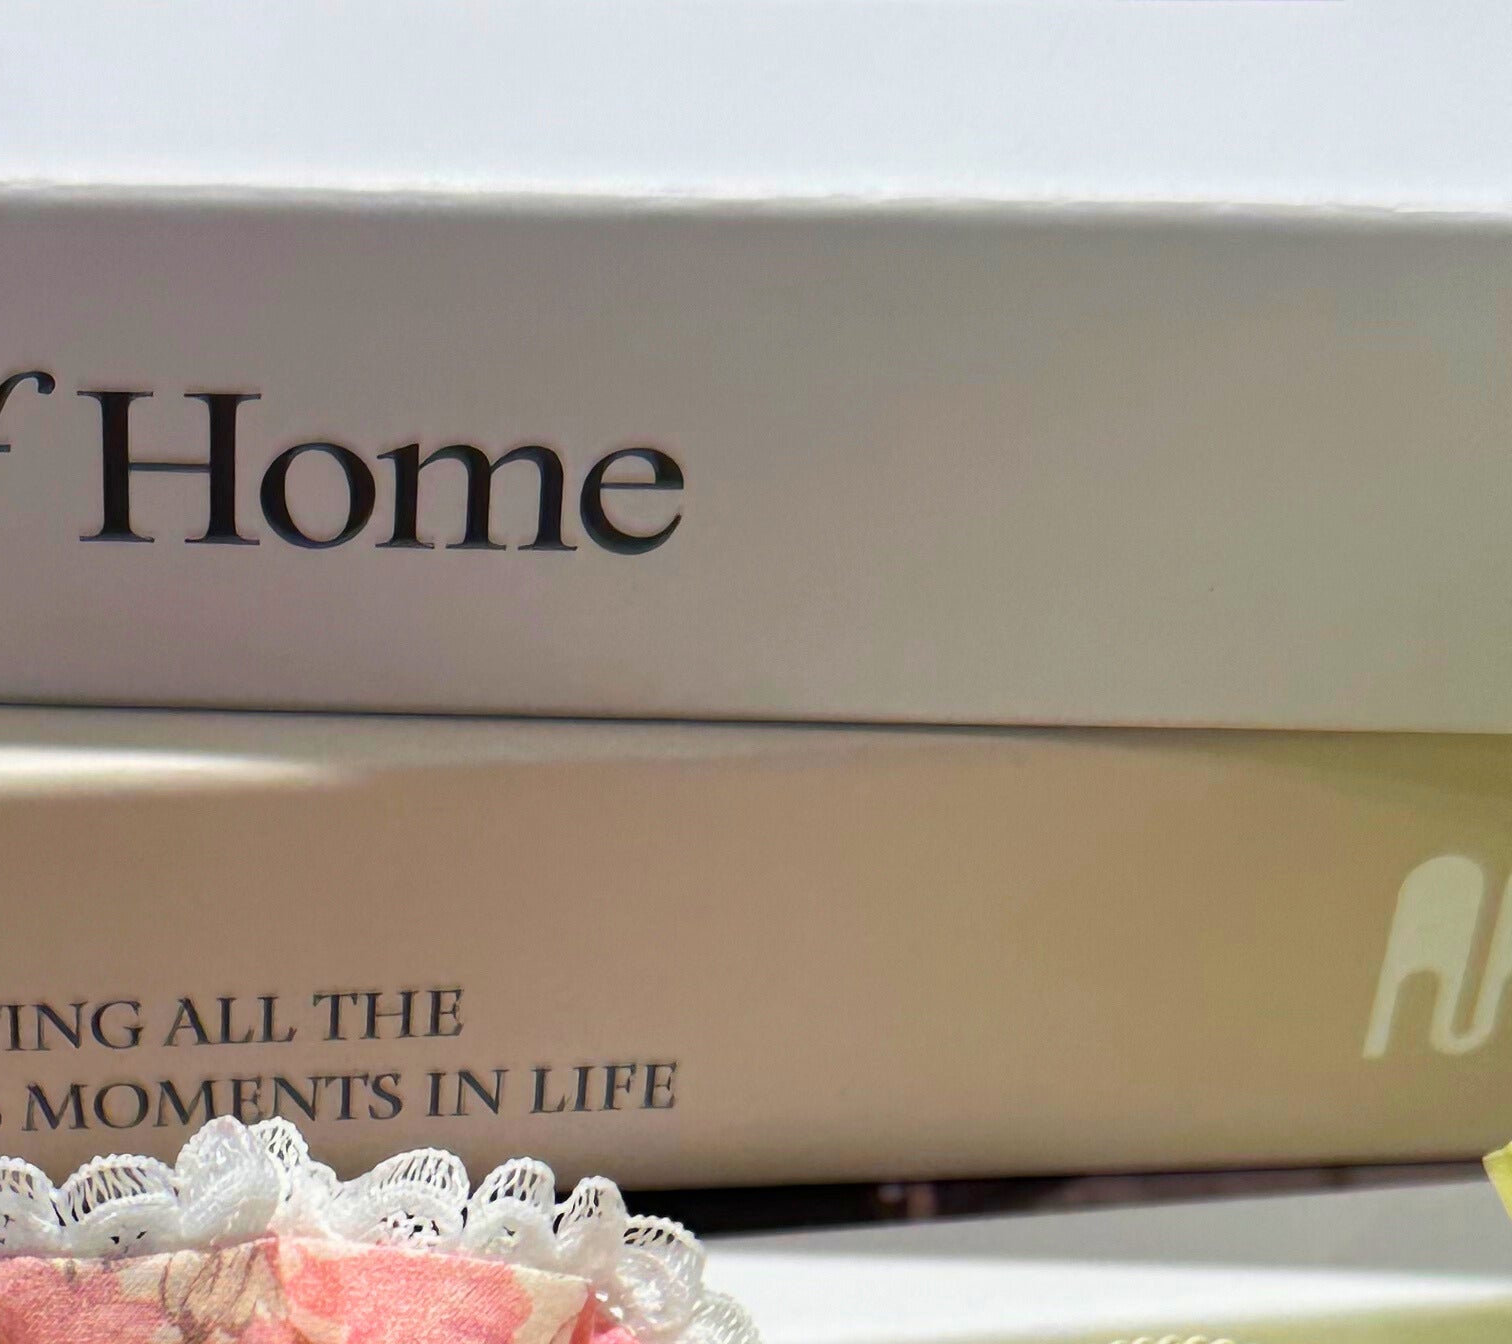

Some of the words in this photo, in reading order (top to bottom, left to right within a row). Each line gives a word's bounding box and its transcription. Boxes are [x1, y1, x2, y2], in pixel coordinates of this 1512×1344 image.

[76, 389, 685, 556] Home
[163, 996, 297, 1047] ALL
[312, 987, 464, 1040] THE
[20, 1072, 404, 1133] MOMENTS
[426, 1069, 509, 1117] IN
[529, 1060, 678, 1114] LIFE
